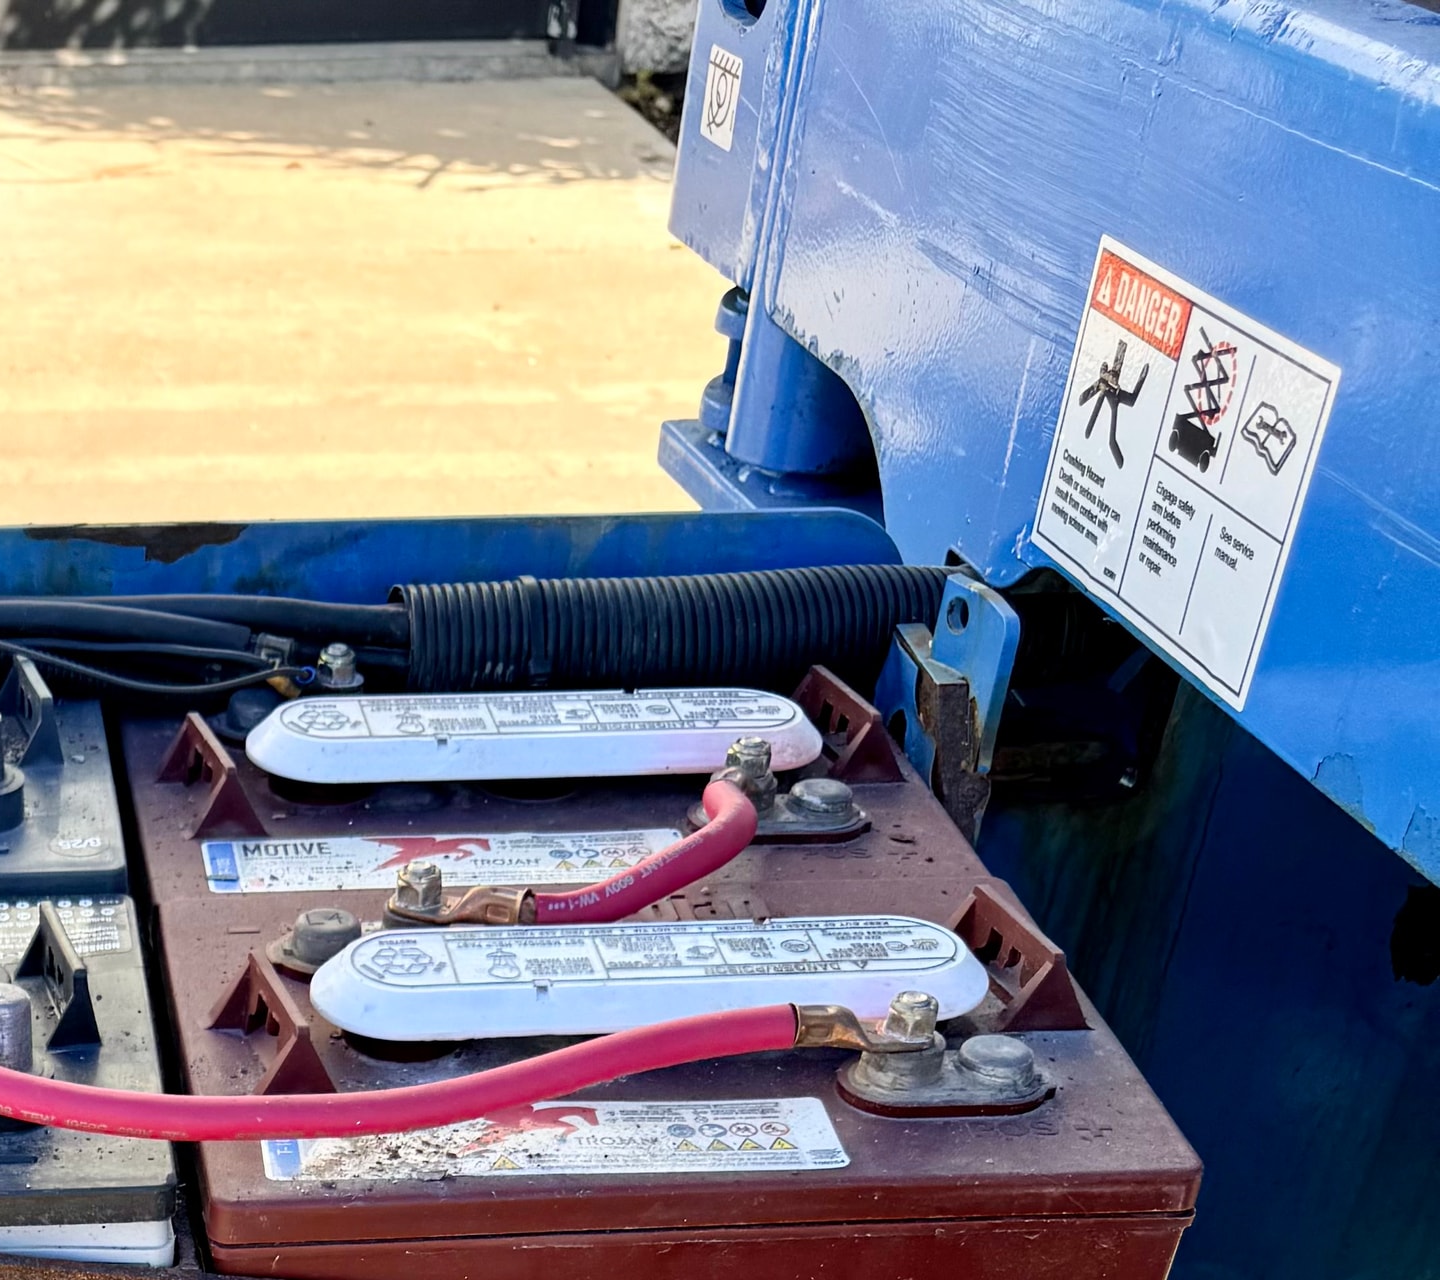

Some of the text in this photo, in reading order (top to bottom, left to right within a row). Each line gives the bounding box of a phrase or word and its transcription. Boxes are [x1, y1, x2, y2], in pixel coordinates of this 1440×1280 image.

[1113, 271, 1182, 347] DANGER
[1062, 448, 1106, 489] Crushing Hazard
[1059, 467, 1074, 487] Death
[1079, 484, 1097, 506] serious
[1096, 495, 1111, 518] injury
[1155, 480, 1196, 521] Engage safety
[1151, 500, 1182, 529] arm before
[1145, 517, 1177, 549] performing
[1219, 526, 1255, 561] See service
[1142, 534, 1178, 568] maintenance
[1214, 546, 1238, 572] manual.
[242, 842, 332, 858] MOTIVE
[567, 891, 601, 911] VW-1
[604, 875, 636, 898] 600V
